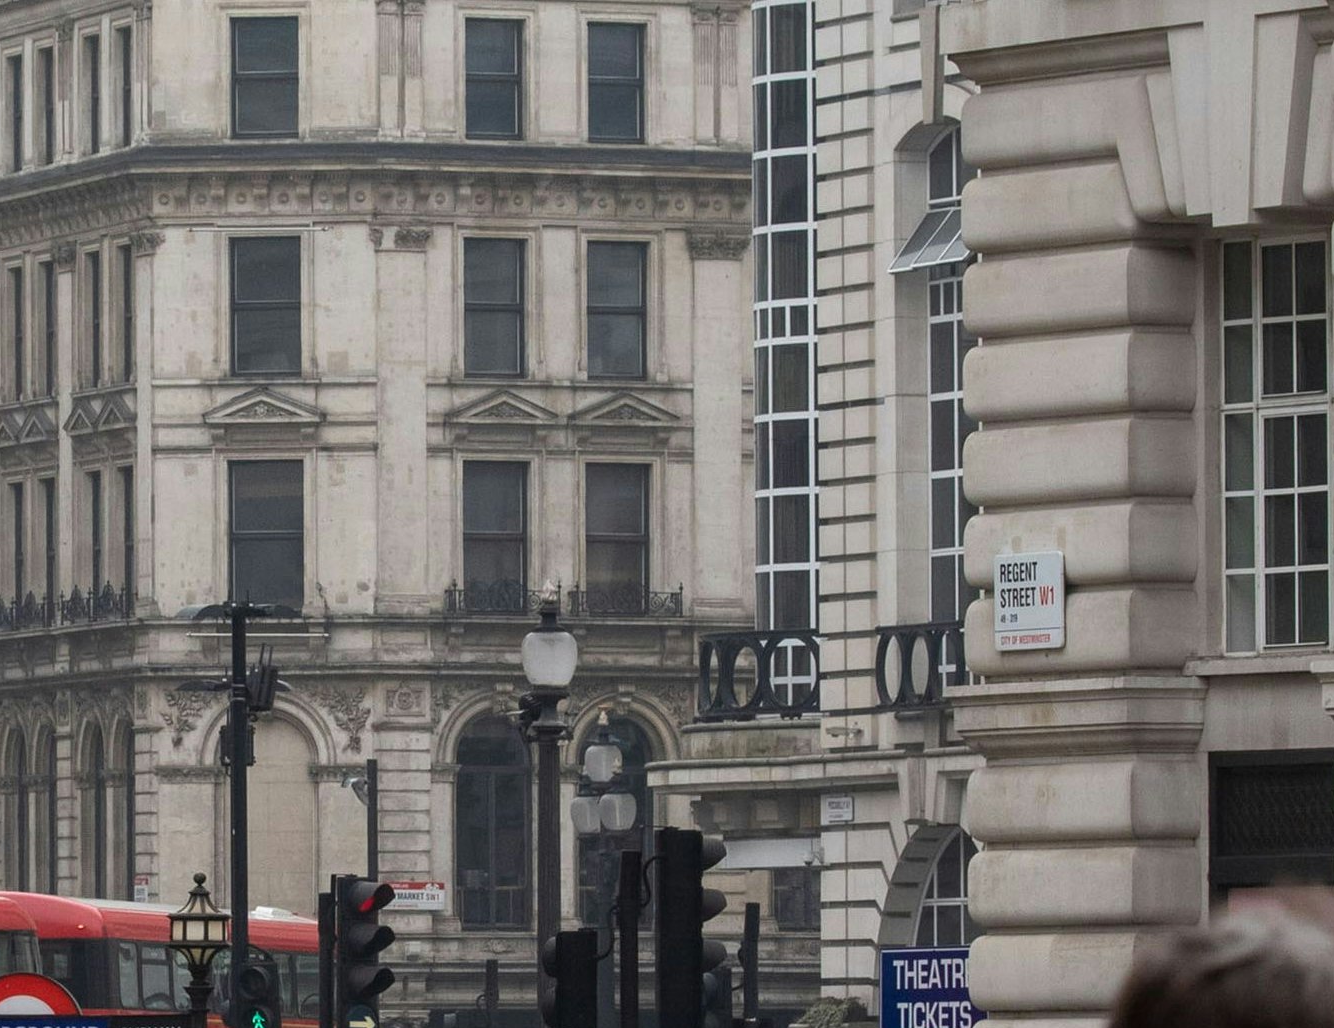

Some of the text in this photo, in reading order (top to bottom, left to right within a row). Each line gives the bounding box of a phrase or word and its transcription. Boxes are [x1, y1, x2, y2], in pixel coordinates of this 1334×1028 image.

[999, 561, 1038, 583] REGENT
[999, 585, 1055, 609] STREET W1
